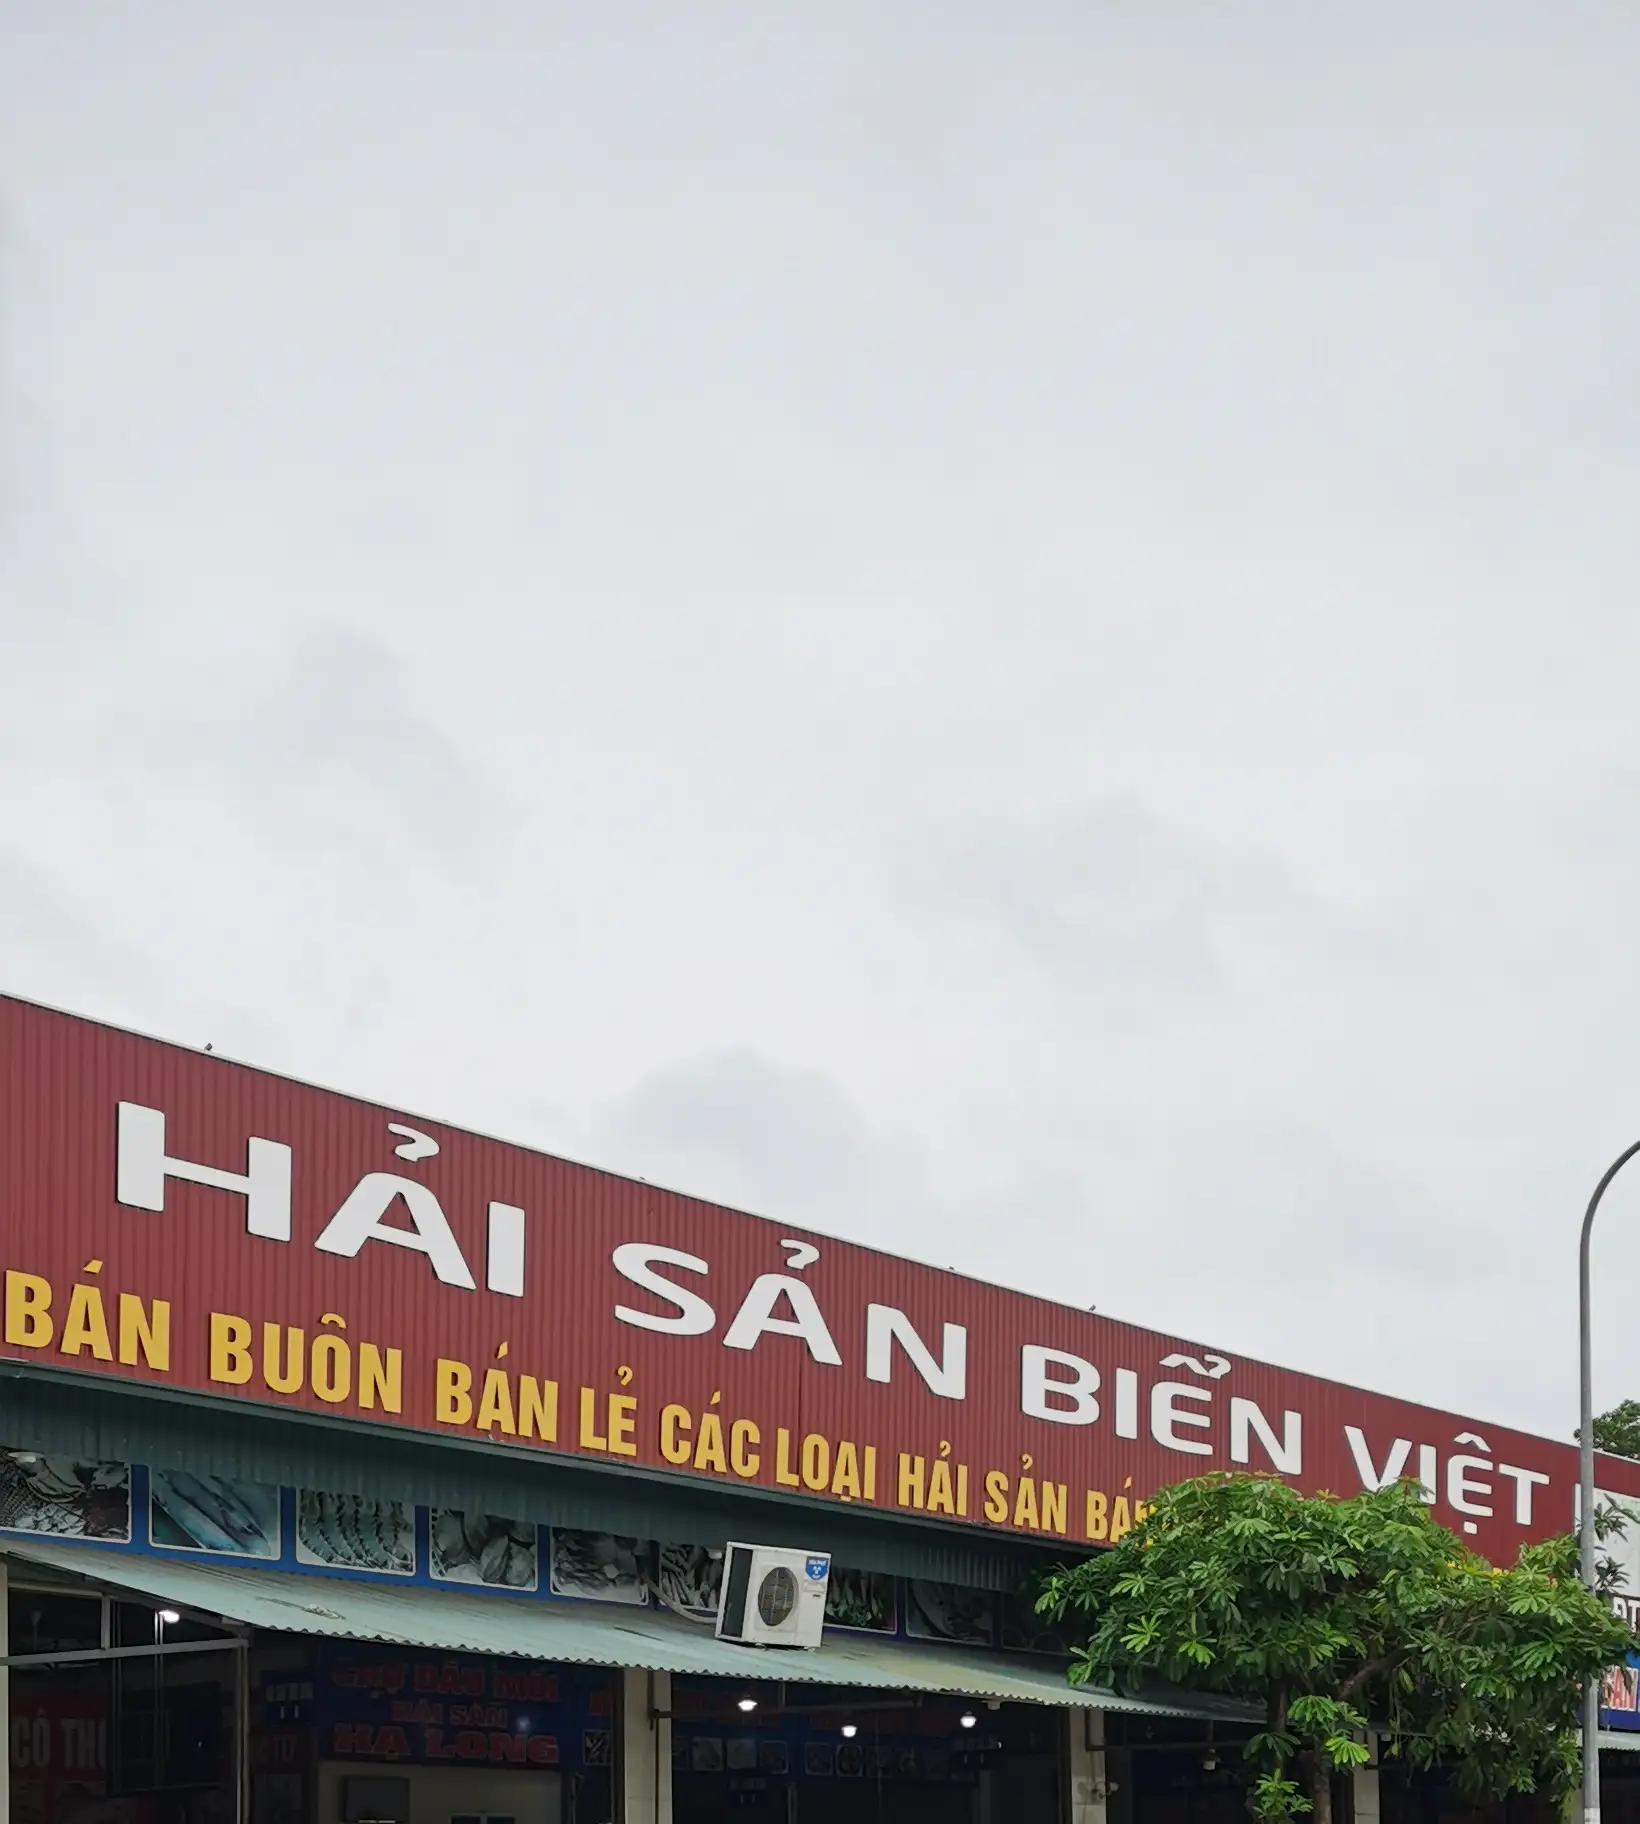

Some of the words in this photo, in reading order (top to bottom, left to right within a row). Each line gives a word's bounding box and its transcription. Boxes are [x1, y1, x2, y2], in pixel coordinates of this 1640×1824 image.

[4, 1260, 171, 1372] BÁN
[209, 1313, 403, 1414] BUÔN
[435, 1342, 559, 1443] BÁN
[579, 1366, 638, 1457] LẺ
[659, 1391, 761, 1479] CÁC
[776, 1428, 876, 1504] LOẠI
[898, 1439, 968, 1517] HẢI
[984, 1453, 1068, 1536] SẢN
[117, 1101, 526, 1298] HẢI
[612, 1238, 967, 1400] SẢN
[1021, 1344, 1303, 1476] BIỂN
[1343, 1425, 1550, 1535] VIỆT
[425, 1726, 561, 1765] LONG
